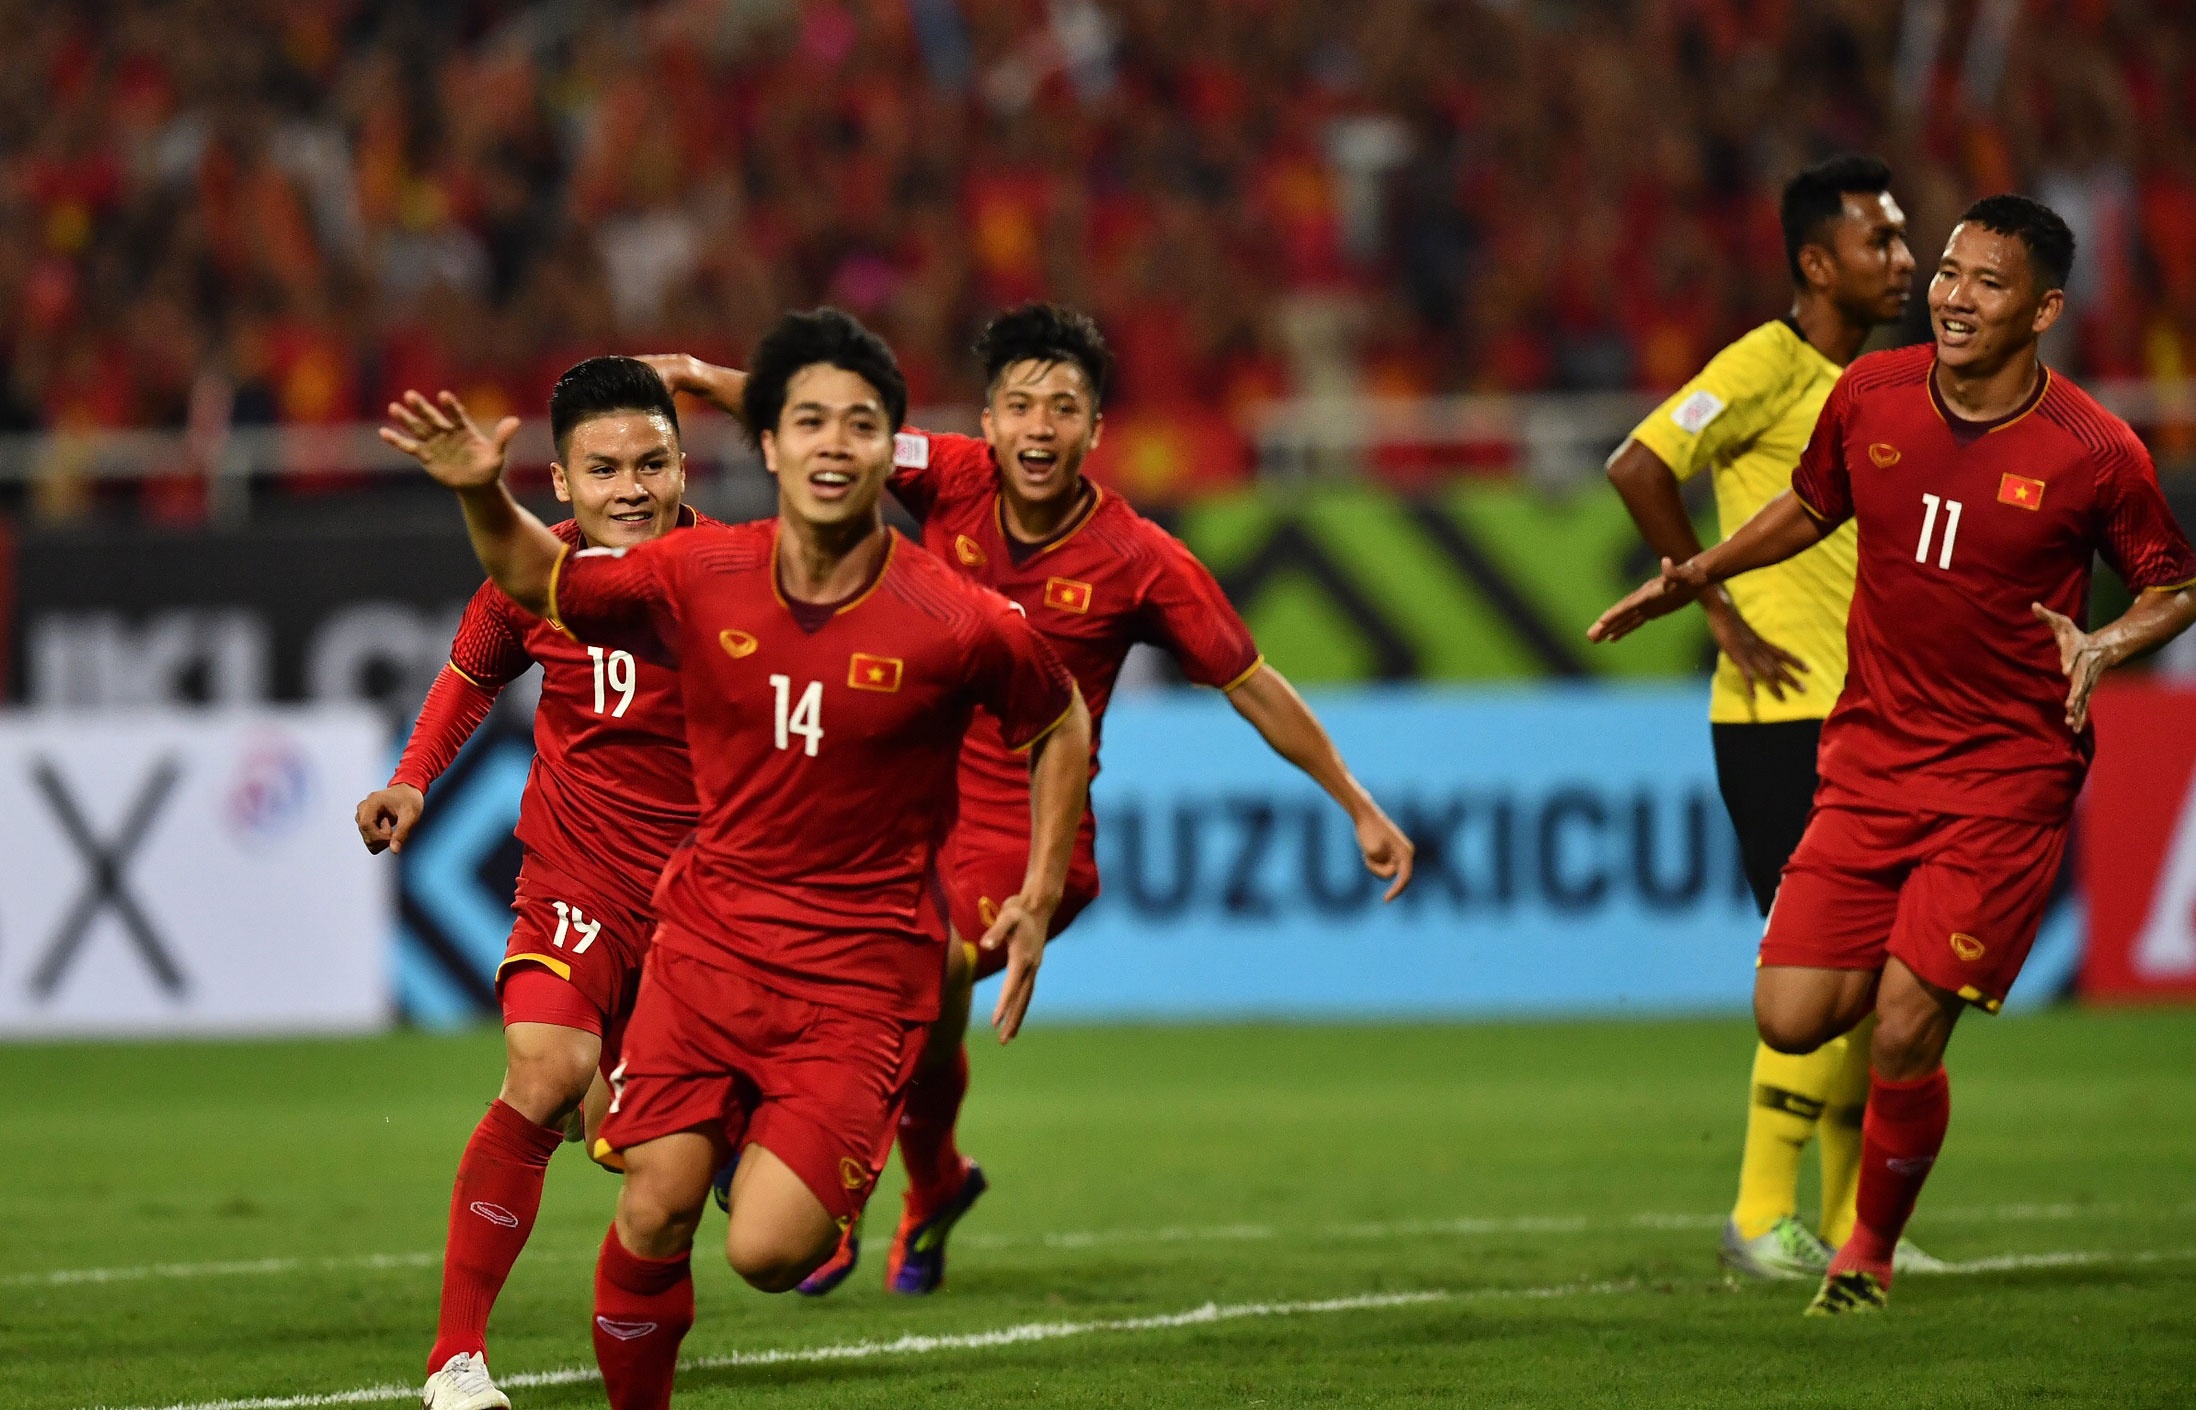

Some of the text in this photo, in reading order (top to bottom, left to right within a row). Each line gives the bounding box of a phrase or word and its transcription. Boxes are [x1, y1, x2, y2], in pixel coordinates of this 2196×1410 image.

[1915, 492, 1963, 570] 11
[587, 645, 636, 718] 19
[769, 674, 824, 757] 14
[1098, 780, 1757, 920] UZUKICU
[551, 900, 602, 954] 19
